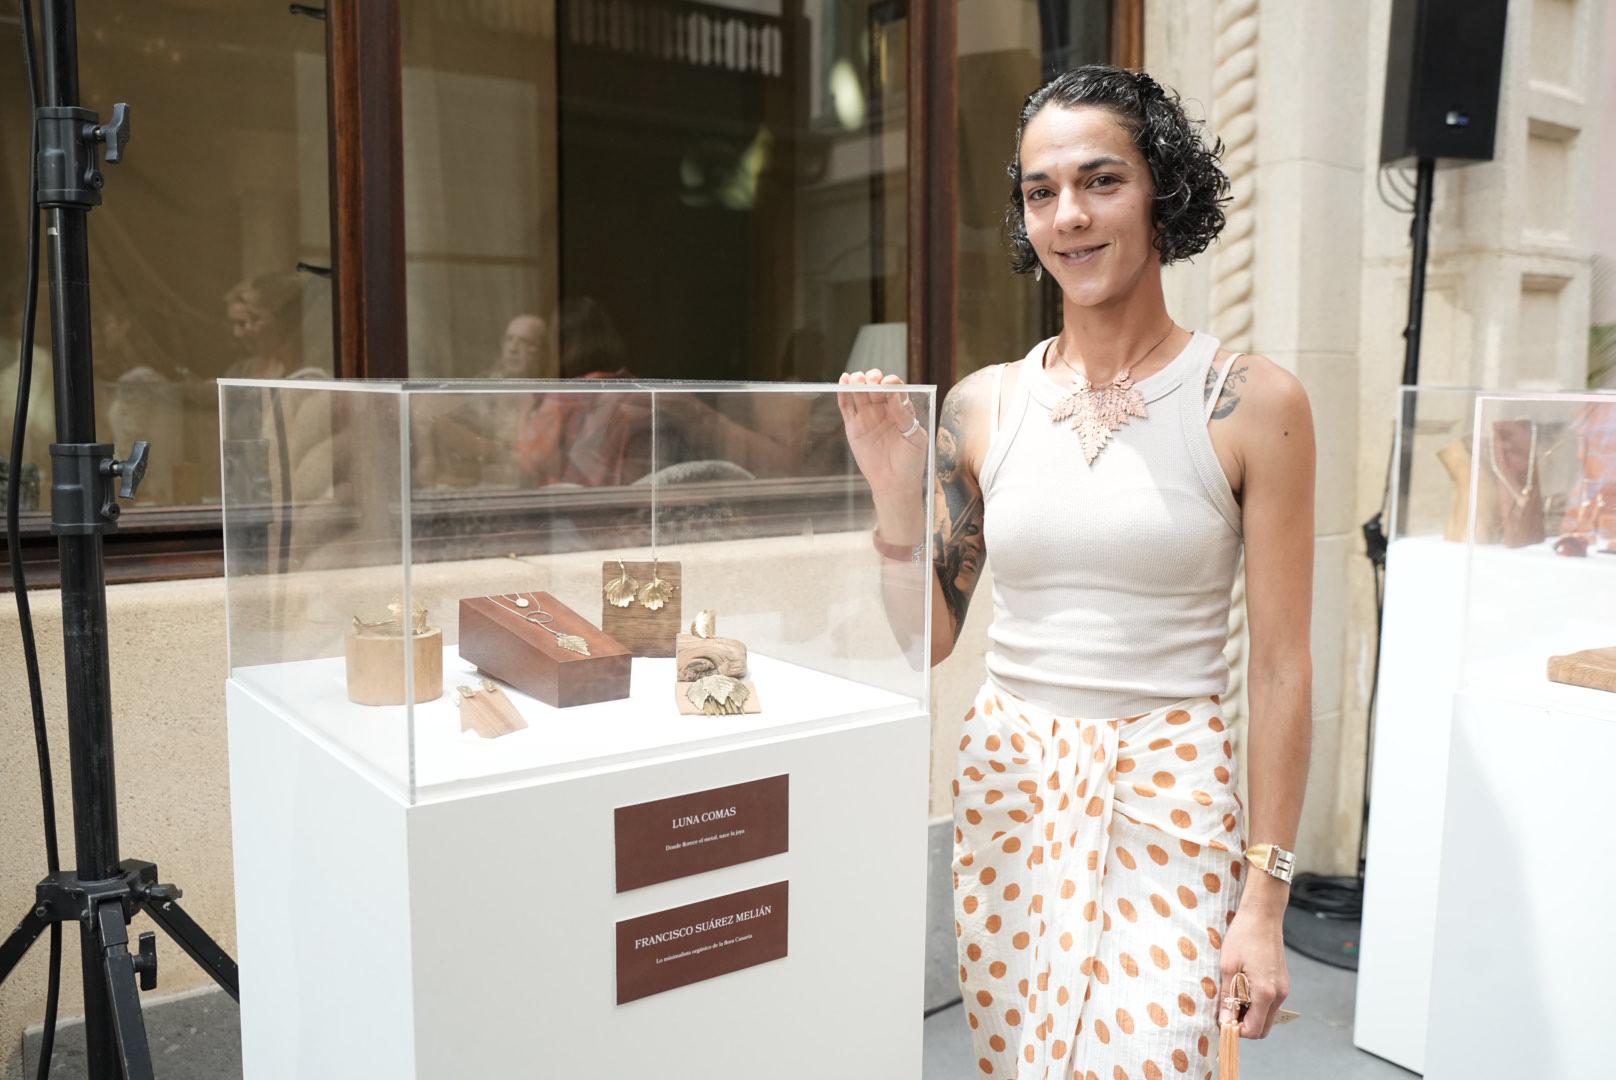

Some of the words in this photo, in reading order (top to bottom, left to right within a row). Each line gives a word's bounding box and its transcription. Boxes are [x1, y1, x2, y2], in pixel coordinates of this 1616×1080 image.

[672, 815, 700, 829] LUNA
[701, 806, 737, 822] COMAS
[665, 843, 682, 851] Donde
[634, 926, 694, 950] FRANCISCO
[695, 915, 734, 934] SUÁREZ
[735, 904, 772, 923] MELIÁN
